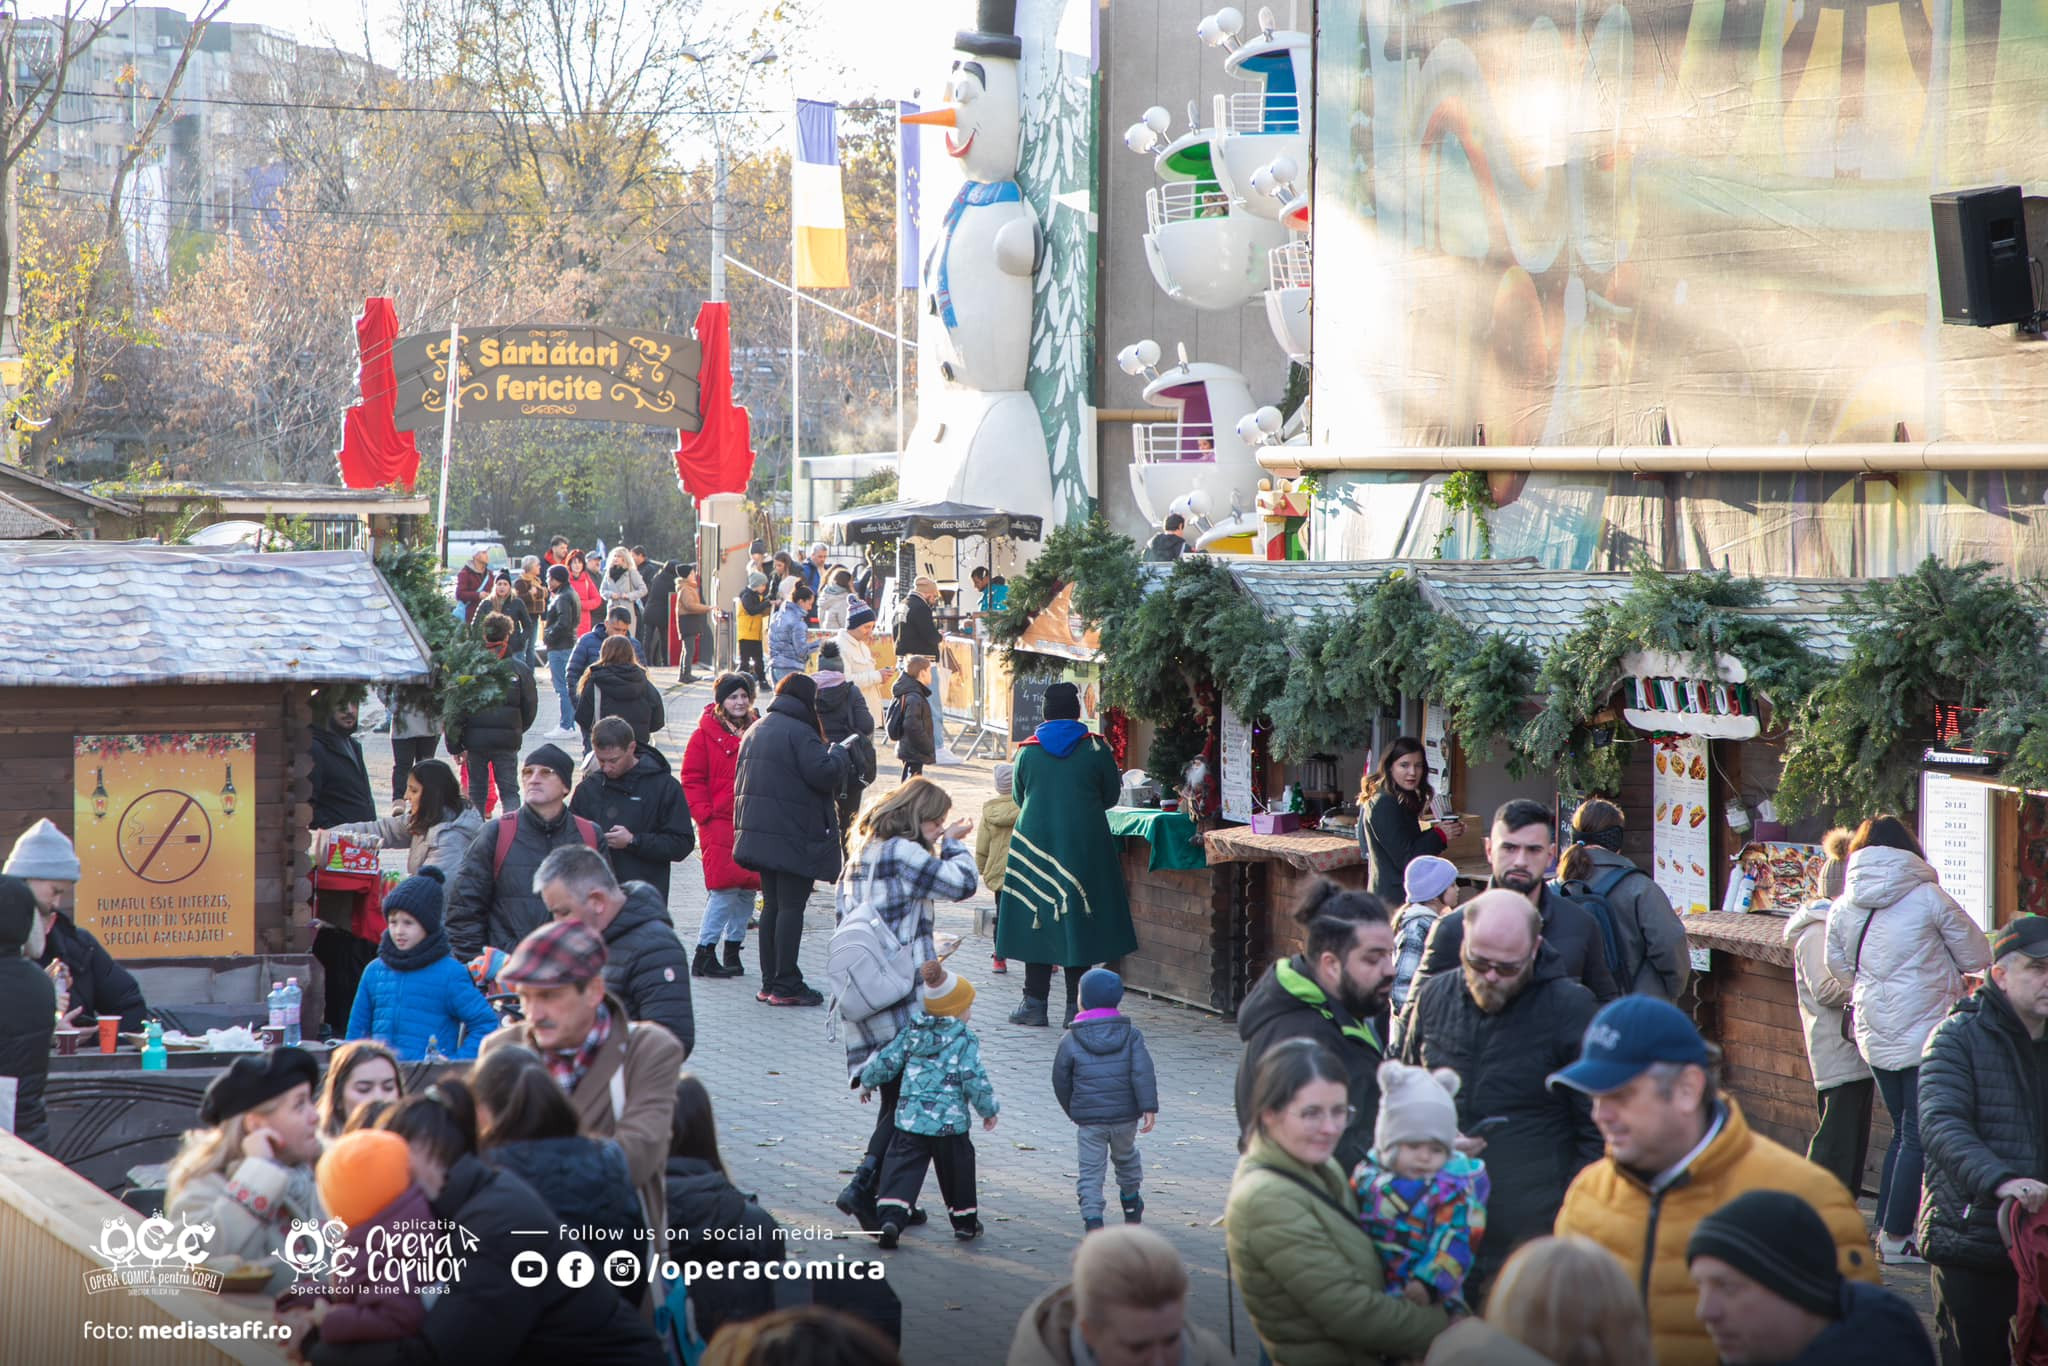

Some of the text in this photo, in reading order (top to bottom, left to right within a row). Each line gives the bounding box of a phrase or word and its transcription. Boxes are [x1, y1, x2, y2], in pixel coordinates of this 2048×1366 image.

[479, 339, 619, 367] Sărbători
[97, 897, 146, 911] FUMATUL
[150, 896, 175, 910] ESTE
[103, 931, 150, 945] SPECIAL
